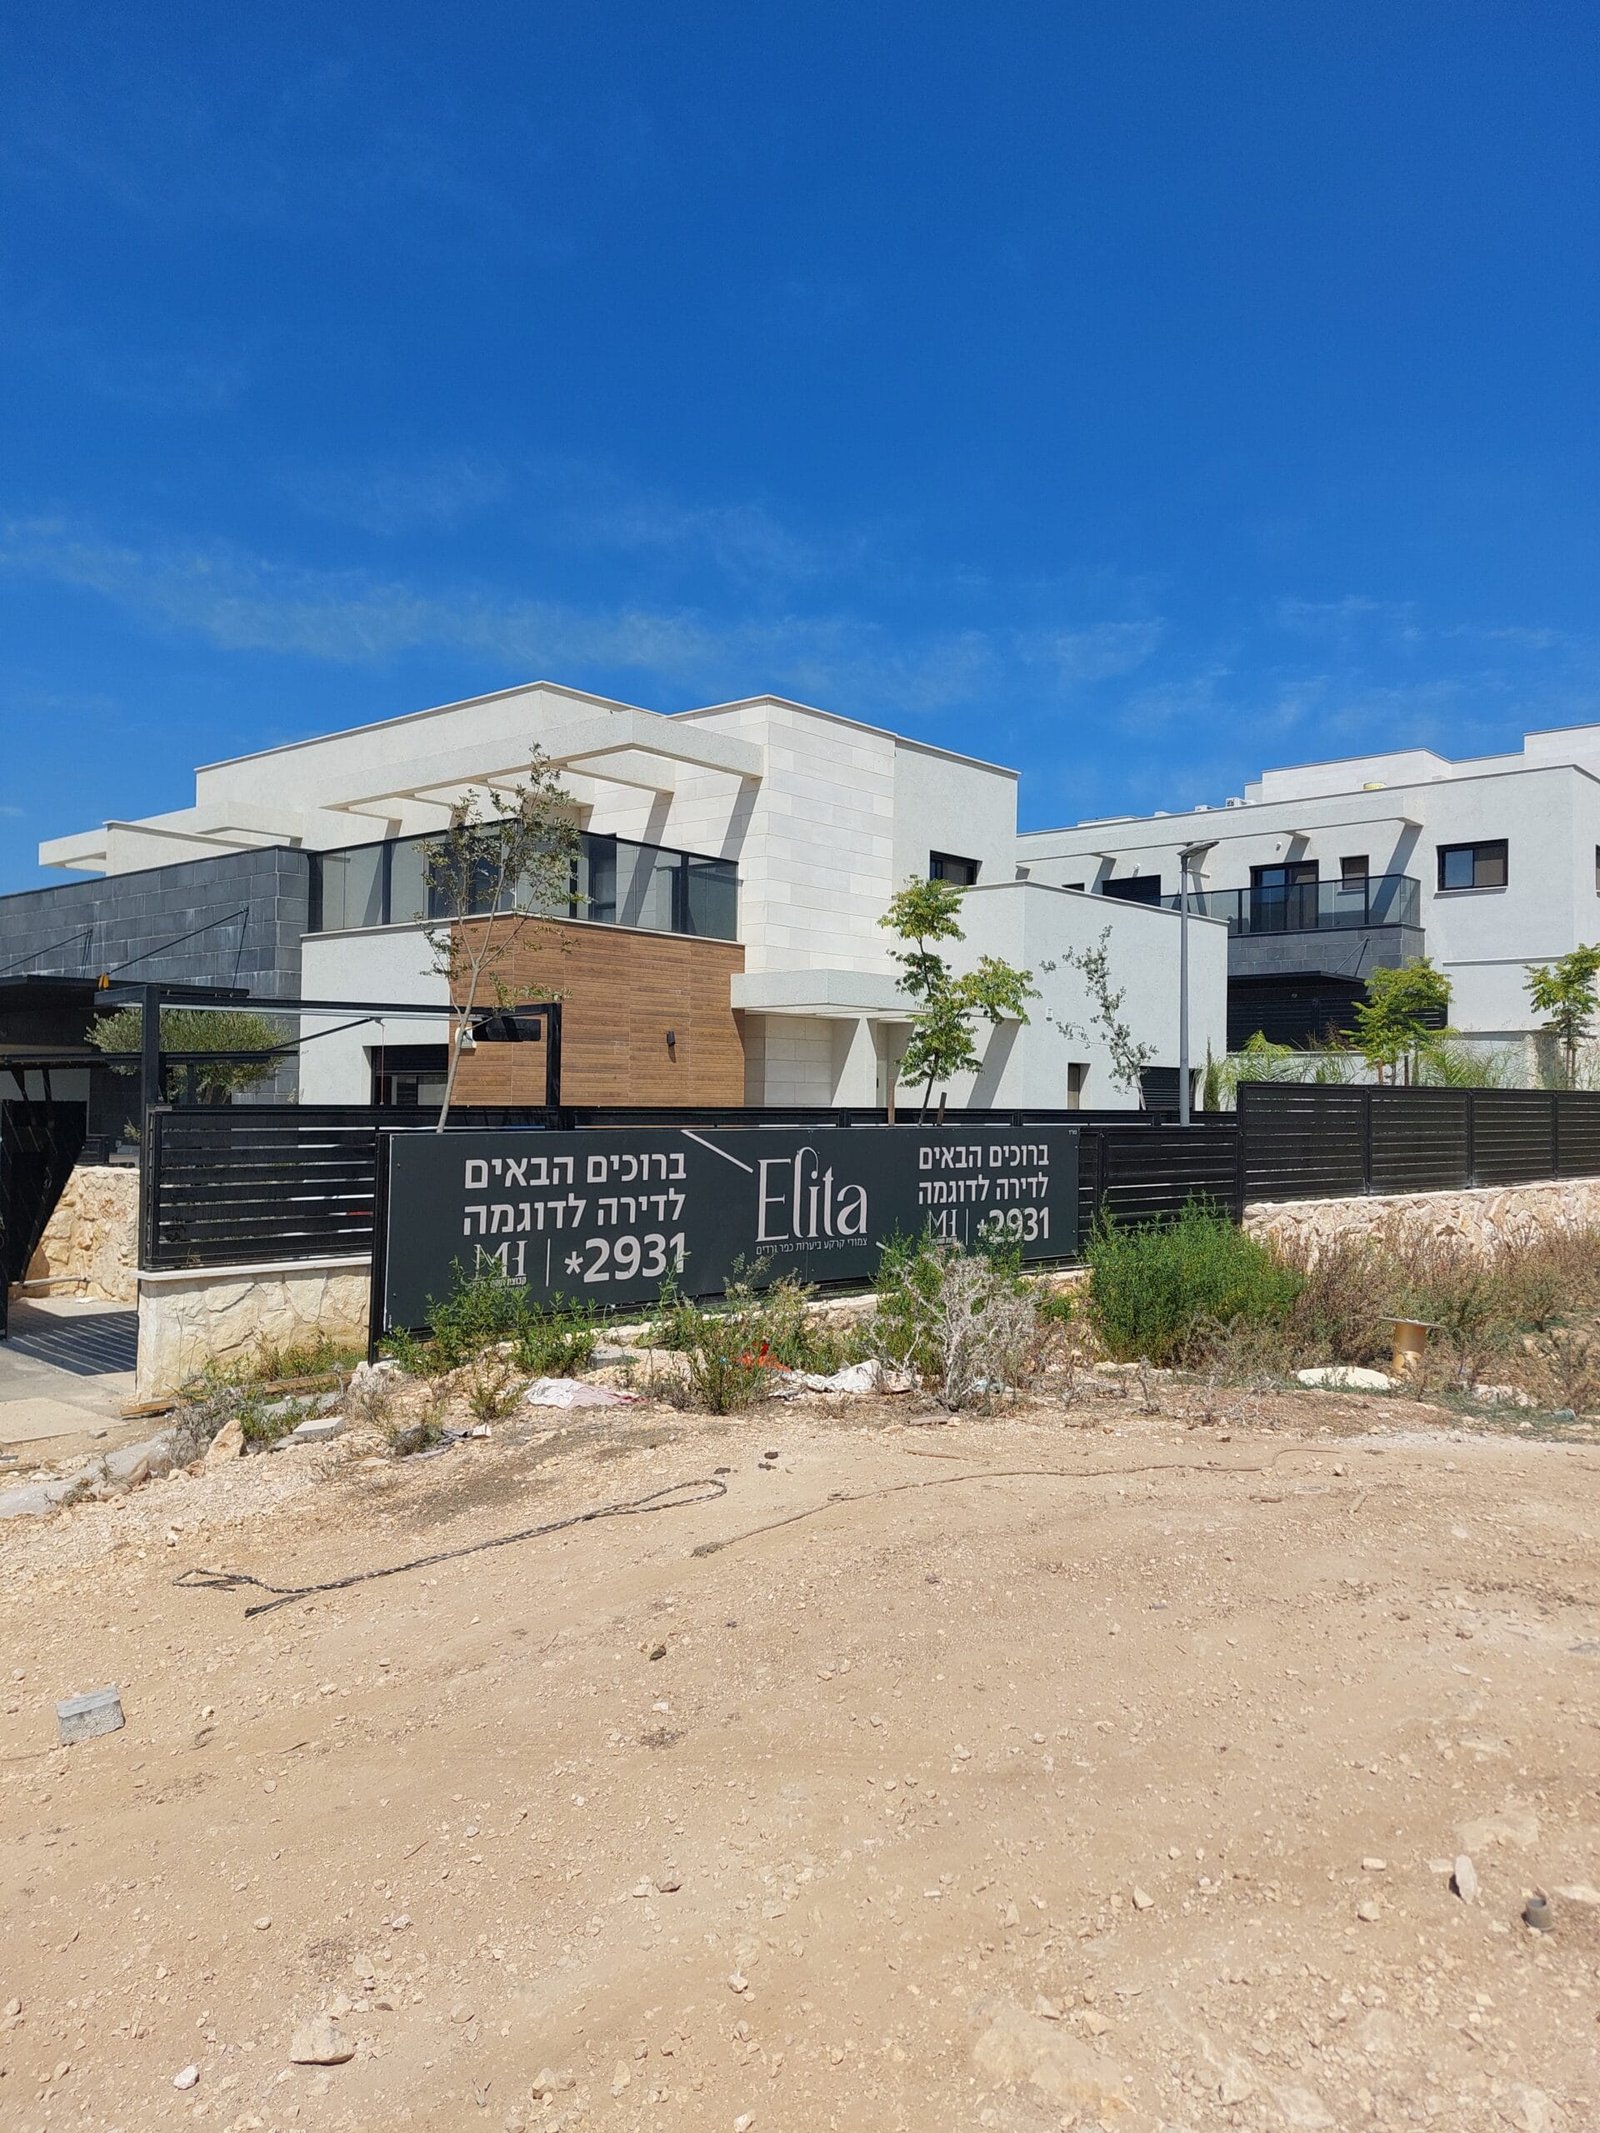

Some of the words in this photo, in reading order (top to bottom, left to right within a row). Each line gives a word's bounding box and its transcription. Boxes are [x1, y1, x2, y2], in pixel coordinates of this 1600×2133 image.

[586, 1152, 687, 1184] ברוכים
[919, 1146, 982, 1170] הבאים
[989, 1144, 1050, 1168] ברוכים
[464, 1156, 574, 1189] הבאים
[996, 1171, 1050, 1201] לדירה
[755, 1146, 868, 1243] Elita
[918, 1174, 990, 1205] לדוגמה
[463, 1192, 587, 1236] לדוגמה
[597, 1187, 686, 1226] לדירה
[779, 1243, 794, 1253] כפר
[796, 1241, 822, 1252] ביערות
[823, 1239, 845, 1250] קרקע
[848, 1237, 868, 1247] צמודי
